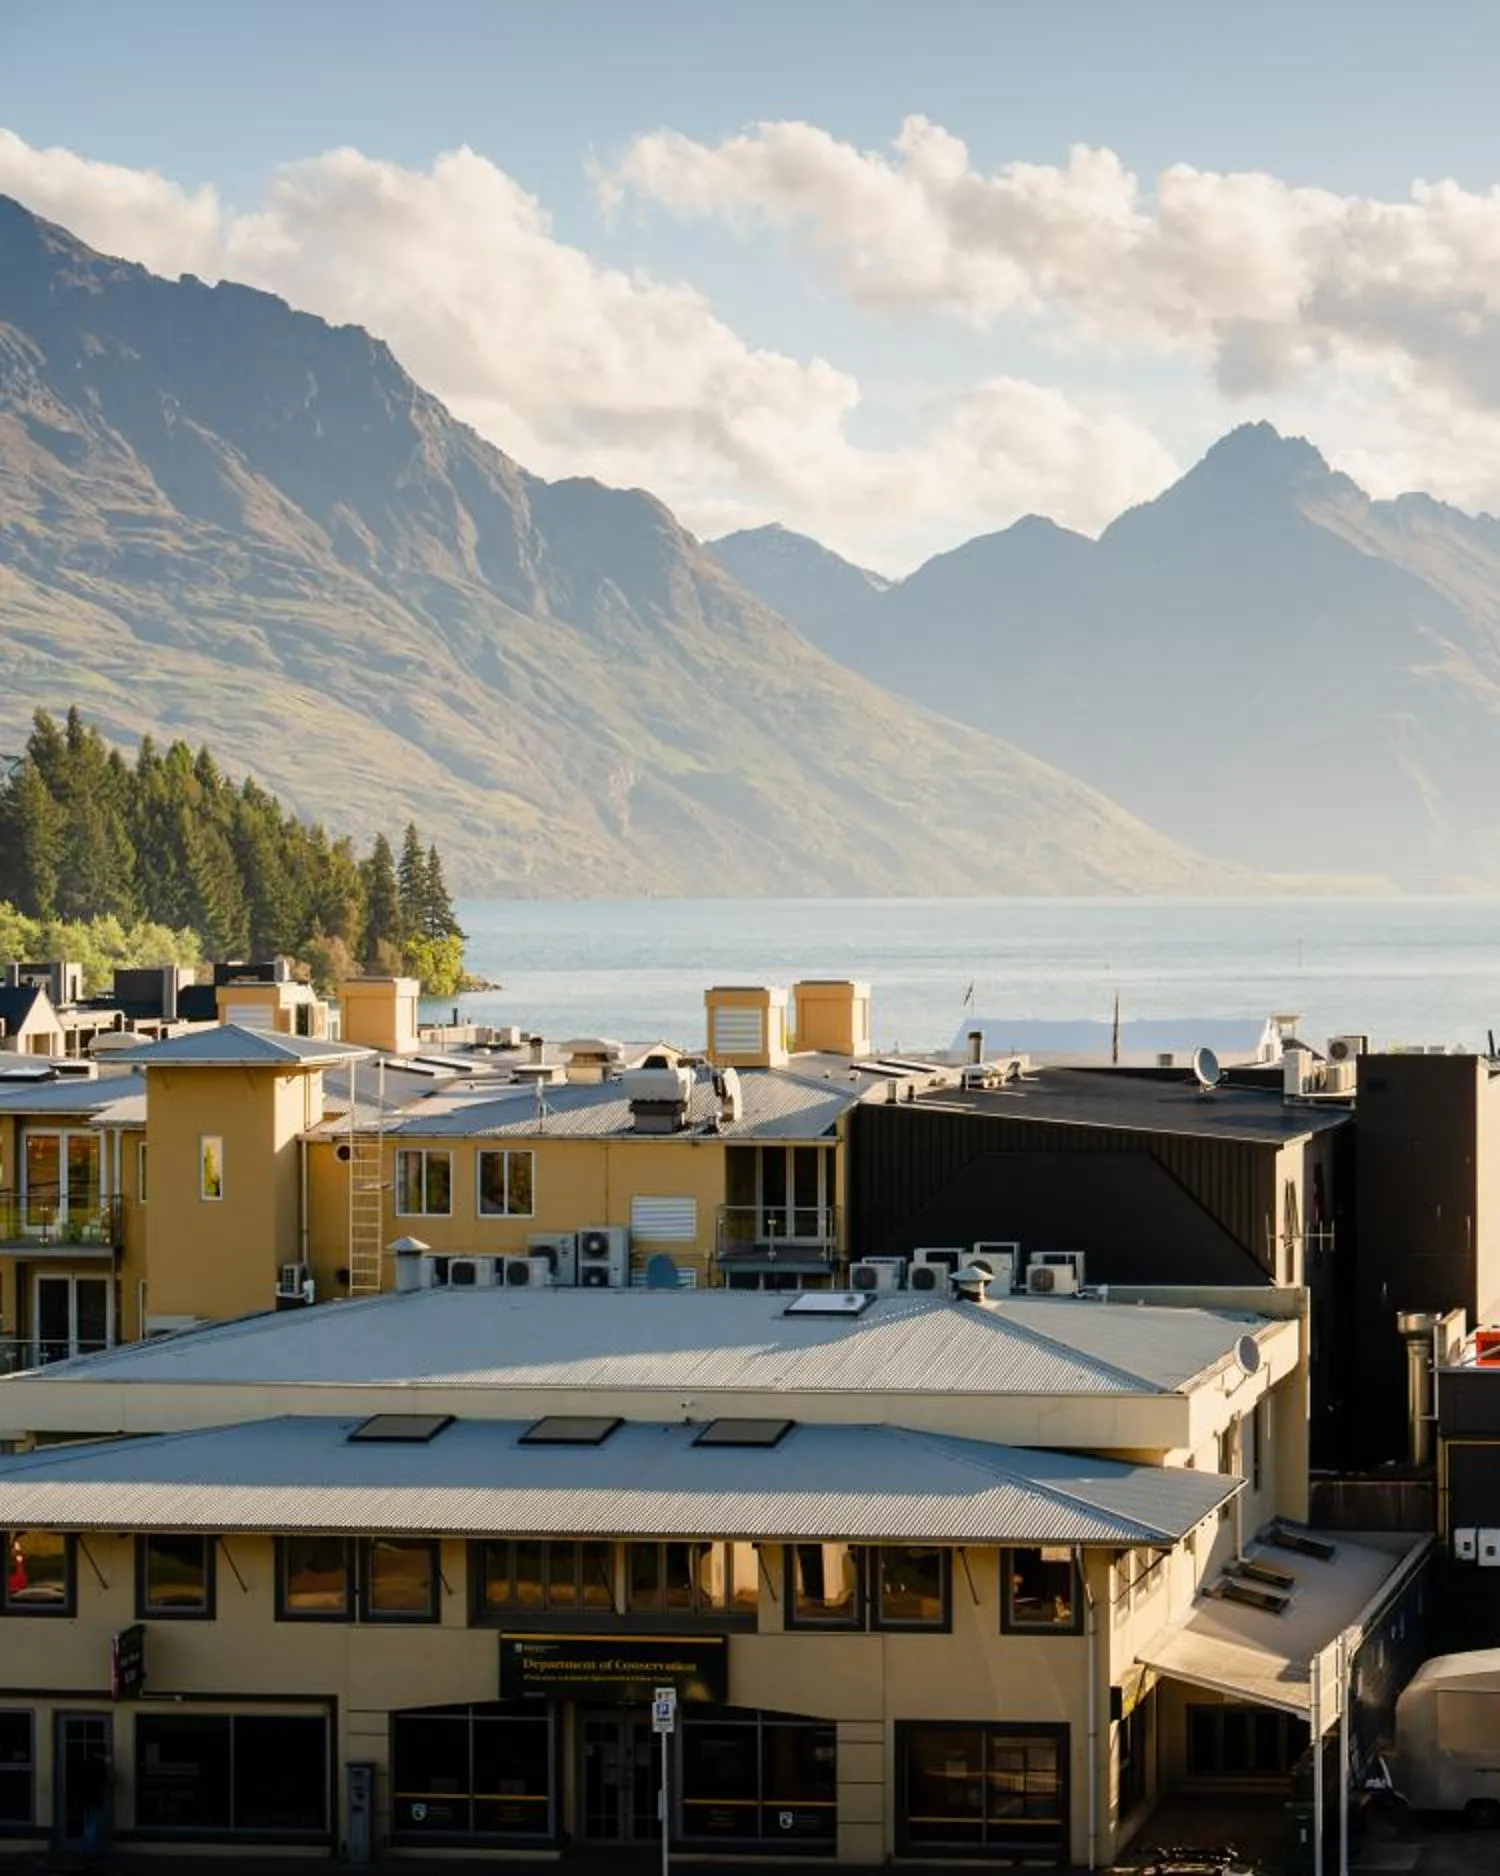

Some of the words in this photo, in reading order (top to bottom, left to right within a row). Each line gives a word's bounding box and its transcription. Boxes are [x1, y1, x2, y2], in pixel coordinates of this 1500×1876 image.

[523, 1658, 596, 1673] Department
[599, 1658, 614, 1671] of
[615, 1658, 697, 1672] Conservation
